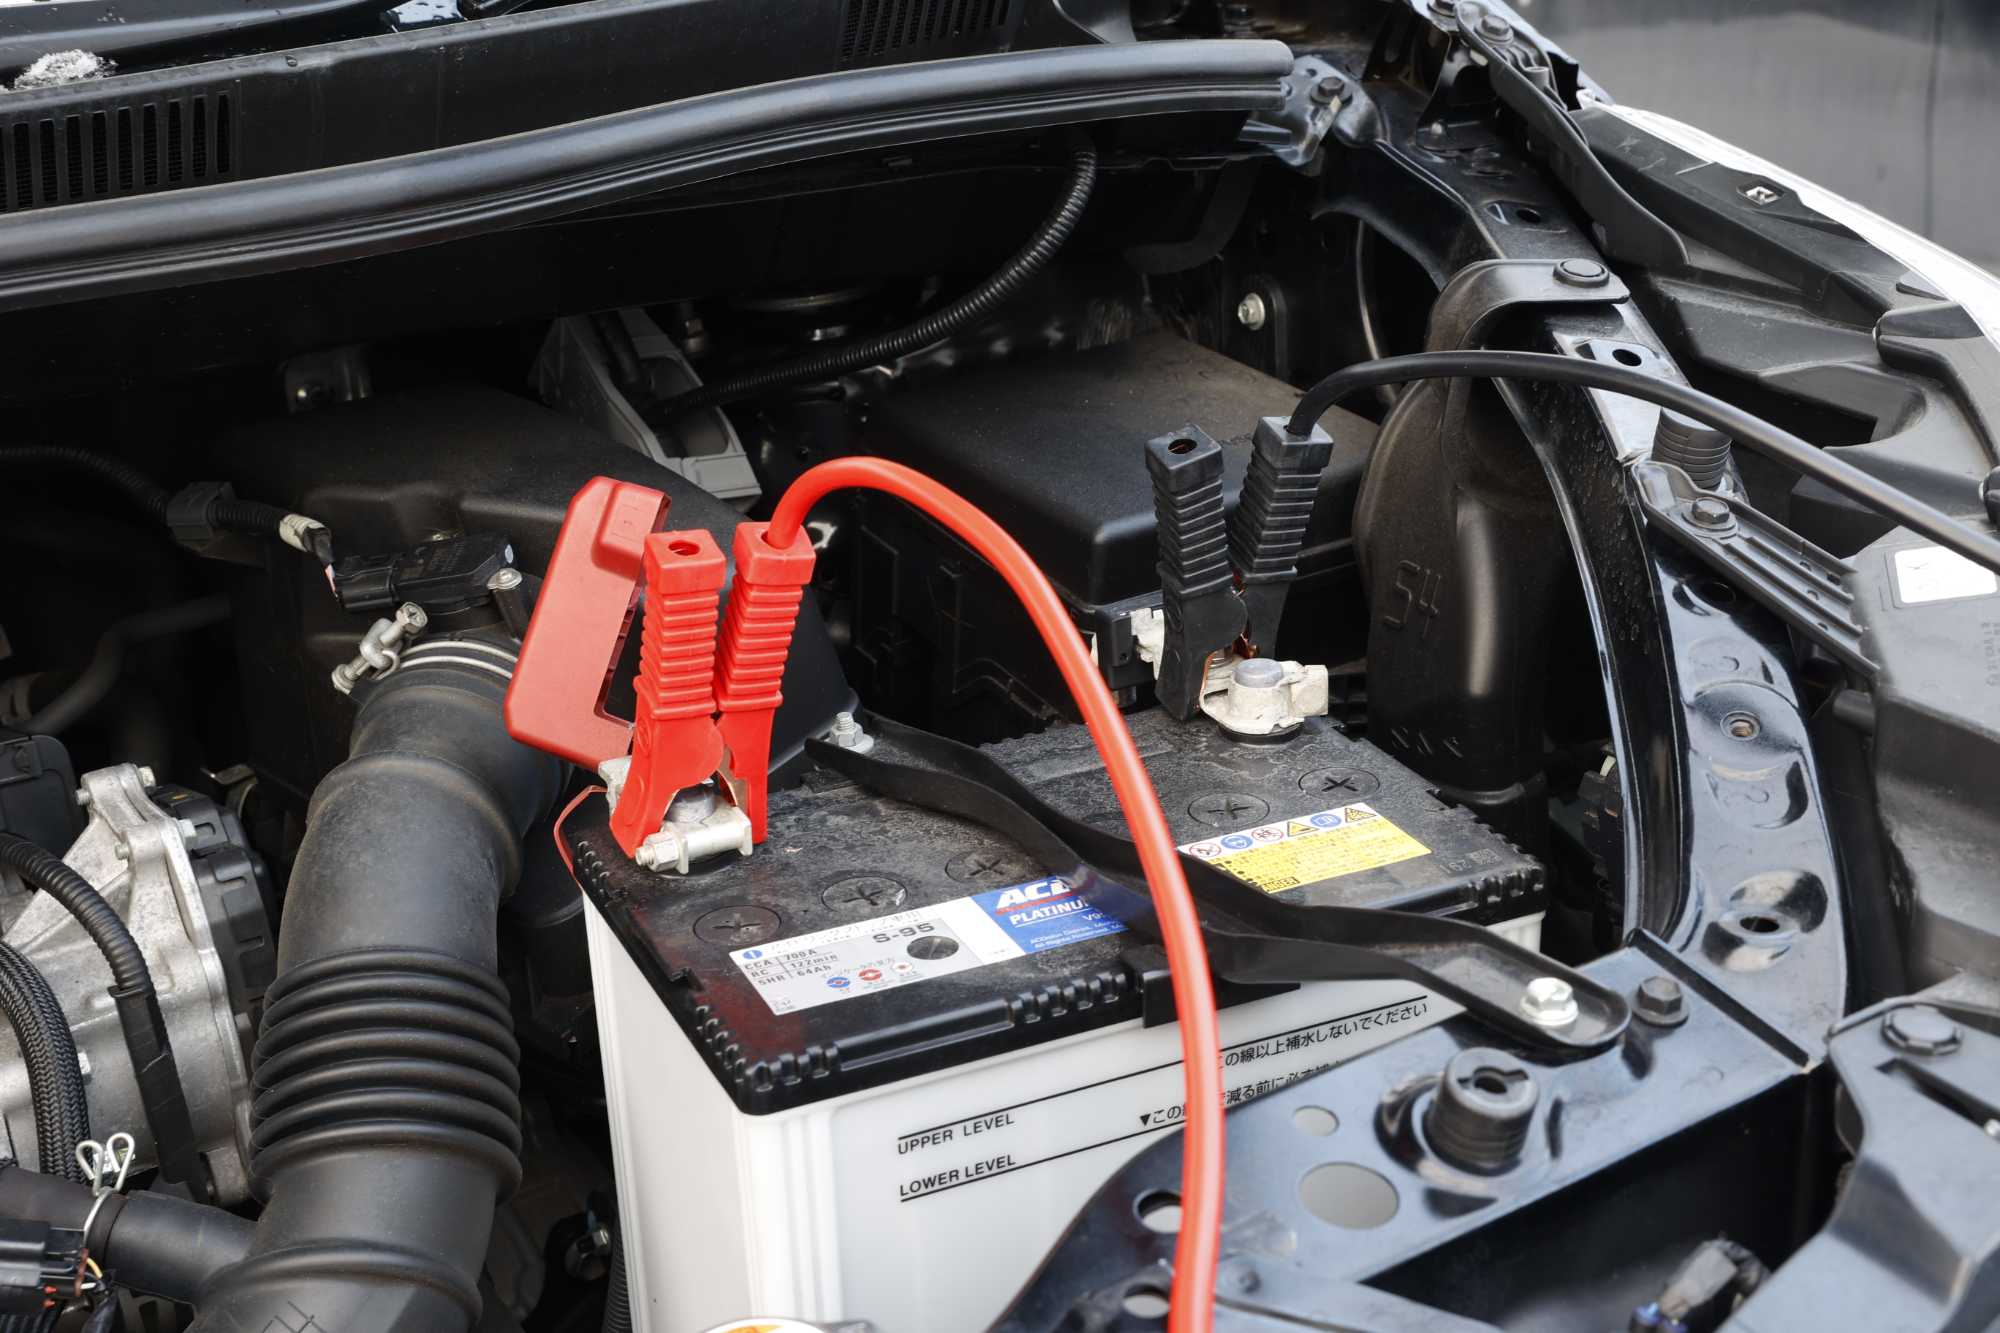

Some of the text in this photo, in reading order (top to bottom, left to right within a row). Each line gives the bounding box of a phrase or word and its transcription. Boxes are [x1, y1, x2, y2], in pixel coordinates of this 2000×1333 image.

[872, 921, 936, 946] S-95
[744, 959, 774, 971] CCA
[750, 969, 770, 979] RC
[758, 973, 786, 986] 5HR
[897, 1112, 1016, 1155] UPPER LEVEL
[899, 1153, 1017, 1197] LOWER LEVEL
